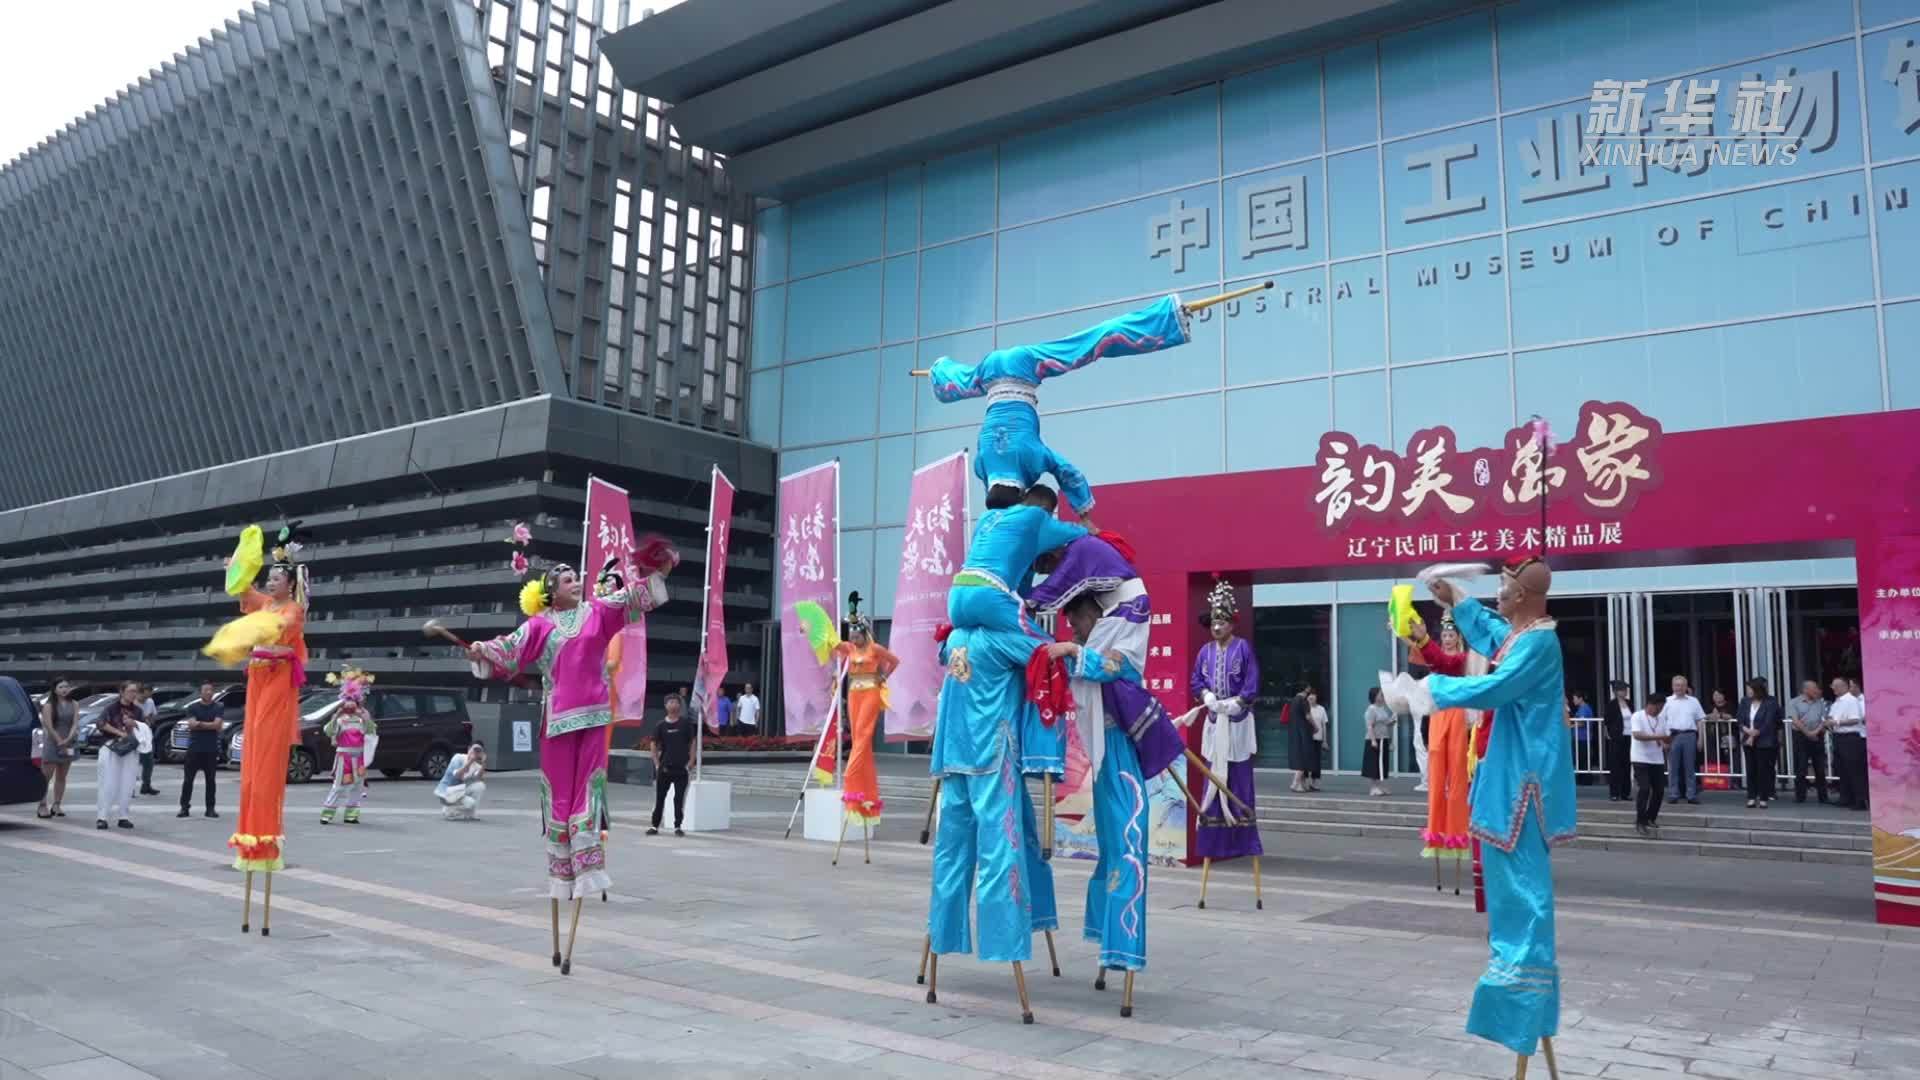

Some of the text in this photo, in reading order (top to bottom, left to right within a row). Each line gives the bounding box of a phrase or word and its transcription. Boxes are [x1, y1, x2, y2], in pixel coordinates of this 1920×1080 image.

[1150, 36, 1920, 275] 中国工业博物
[1199, 278, 1381, 323] DUSTRAL
[1415, 237, 1613, 287] MUSEUM
[1655, 220, 1715, 246] OF
[1347, 521, 1623, 558] 辽宁民间工艺美术精品展
[1875, 586, 1920, 599] 主办单位
[1147, 613, 1172, 625] 品展
